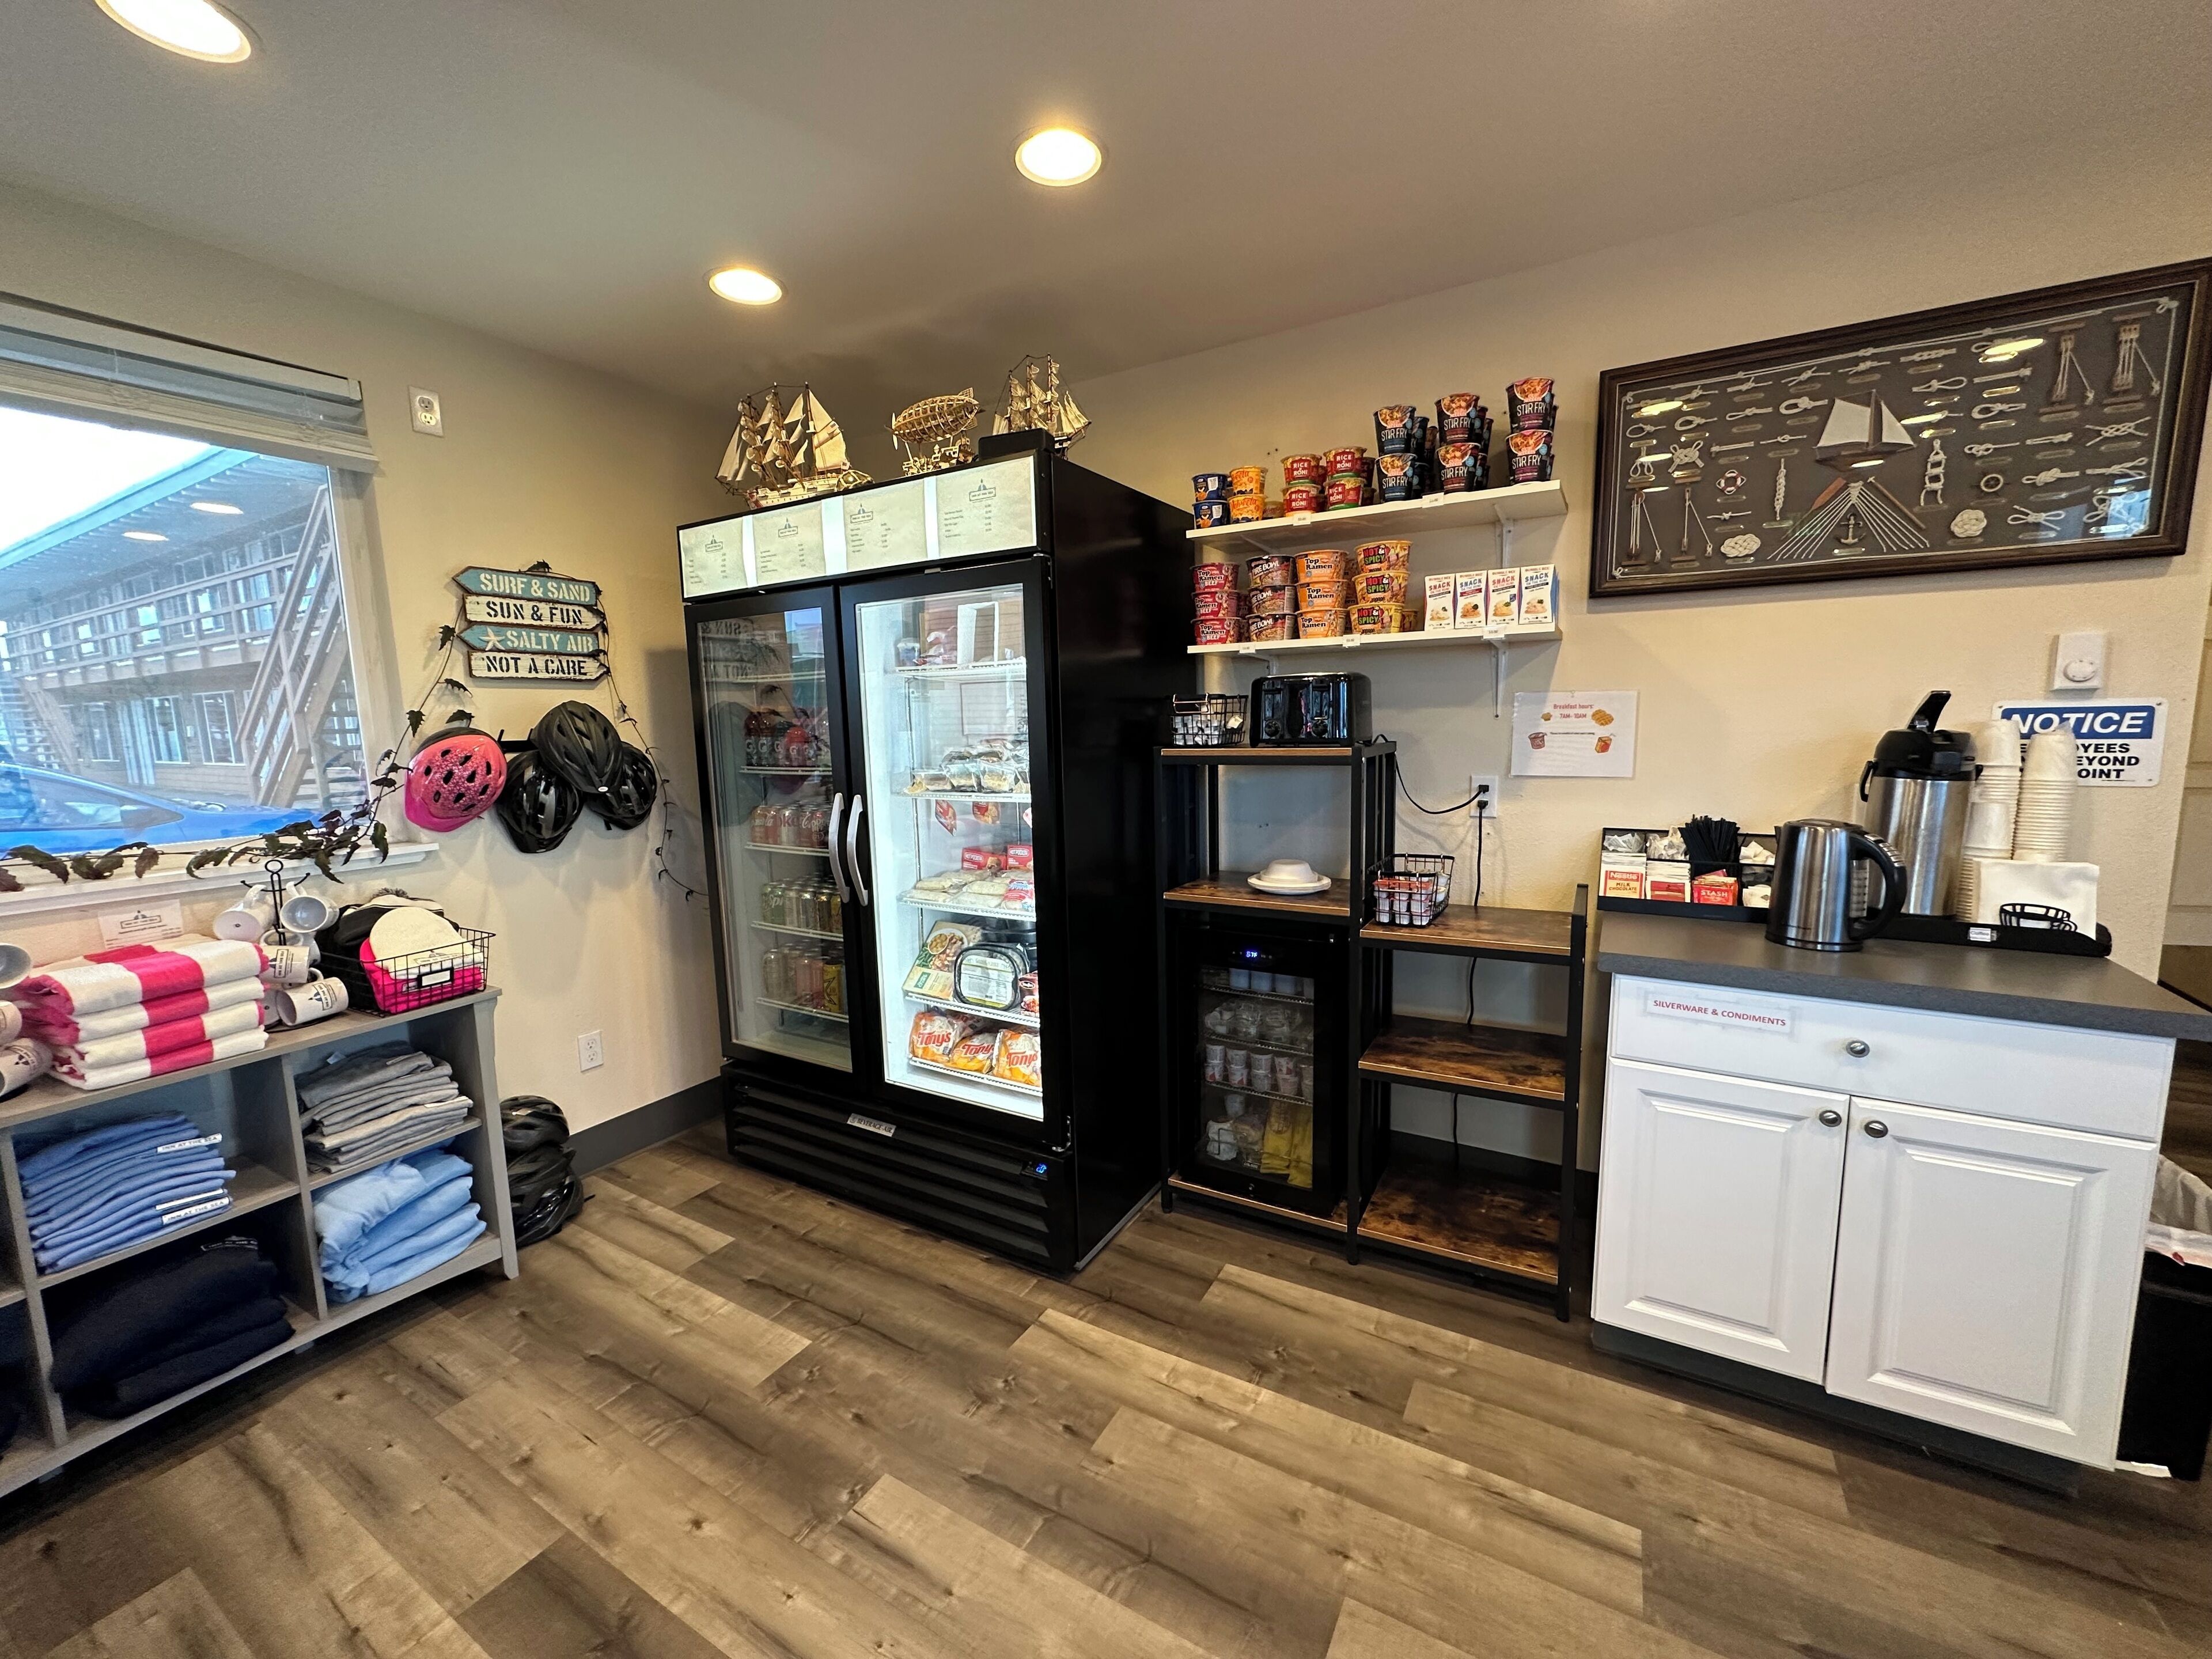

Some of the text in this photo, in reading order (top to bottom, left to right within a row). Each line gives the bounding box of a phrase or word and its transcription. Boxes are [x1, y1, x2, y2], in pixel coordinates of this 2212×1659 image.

[1517, 402, 1546, 416] STIR FRY
[1444, 416, 1472, 430] STIR FRY
[1381, 428, 1408, 441] STIR FRY
[1512, 454, 1541, 469] STIR FRY
[1441, 466, 1468, 480] STIR FRY
[1382, 476, 1408, 489] STIR FRY
[1364, 547, 1378, 556] HOT
[1365, 554, 1385, 565] SPICY
[1262, 561, 1279, 572] BOWL
[1366, 575, 1382, 585] HOT
[1460, 578, 1482, 588] SNACK
[1492, 576, 1515, 585] SNACK
[1525, 573, 1549, 582] SNACK
[479, 573, 590, 602] SURF & SAND
[1367, 585, 1388, 593] SPICY
[1429, 581, 1450, 591] SNACK
[1257, 590, 1272, 601] BOWL
[486, 600, 582, 624] SUN & FUN
[1358, 607, 1373, 616] HOT
[1257, 619, 1272, 629] BOWL
[1358, 616, 1378, 624] SPICY
[506, 630, 593, 652] SALTY AIR
[486, 656, 588, 676] NOT A CARE
[2009, 712, 2148, 734] NOTICE
[2076, 756, 2139, 766] EYOND
[2077, 768, 2124, 779] OINT
[1653, 1000, 1709, 1014] SILVERWARE
[1721, 1010, 1786, 1026] CONDIMENTS
[918, 1031, 952, 1047] Tony's
[962, 1043, 994, 1055] Tony
